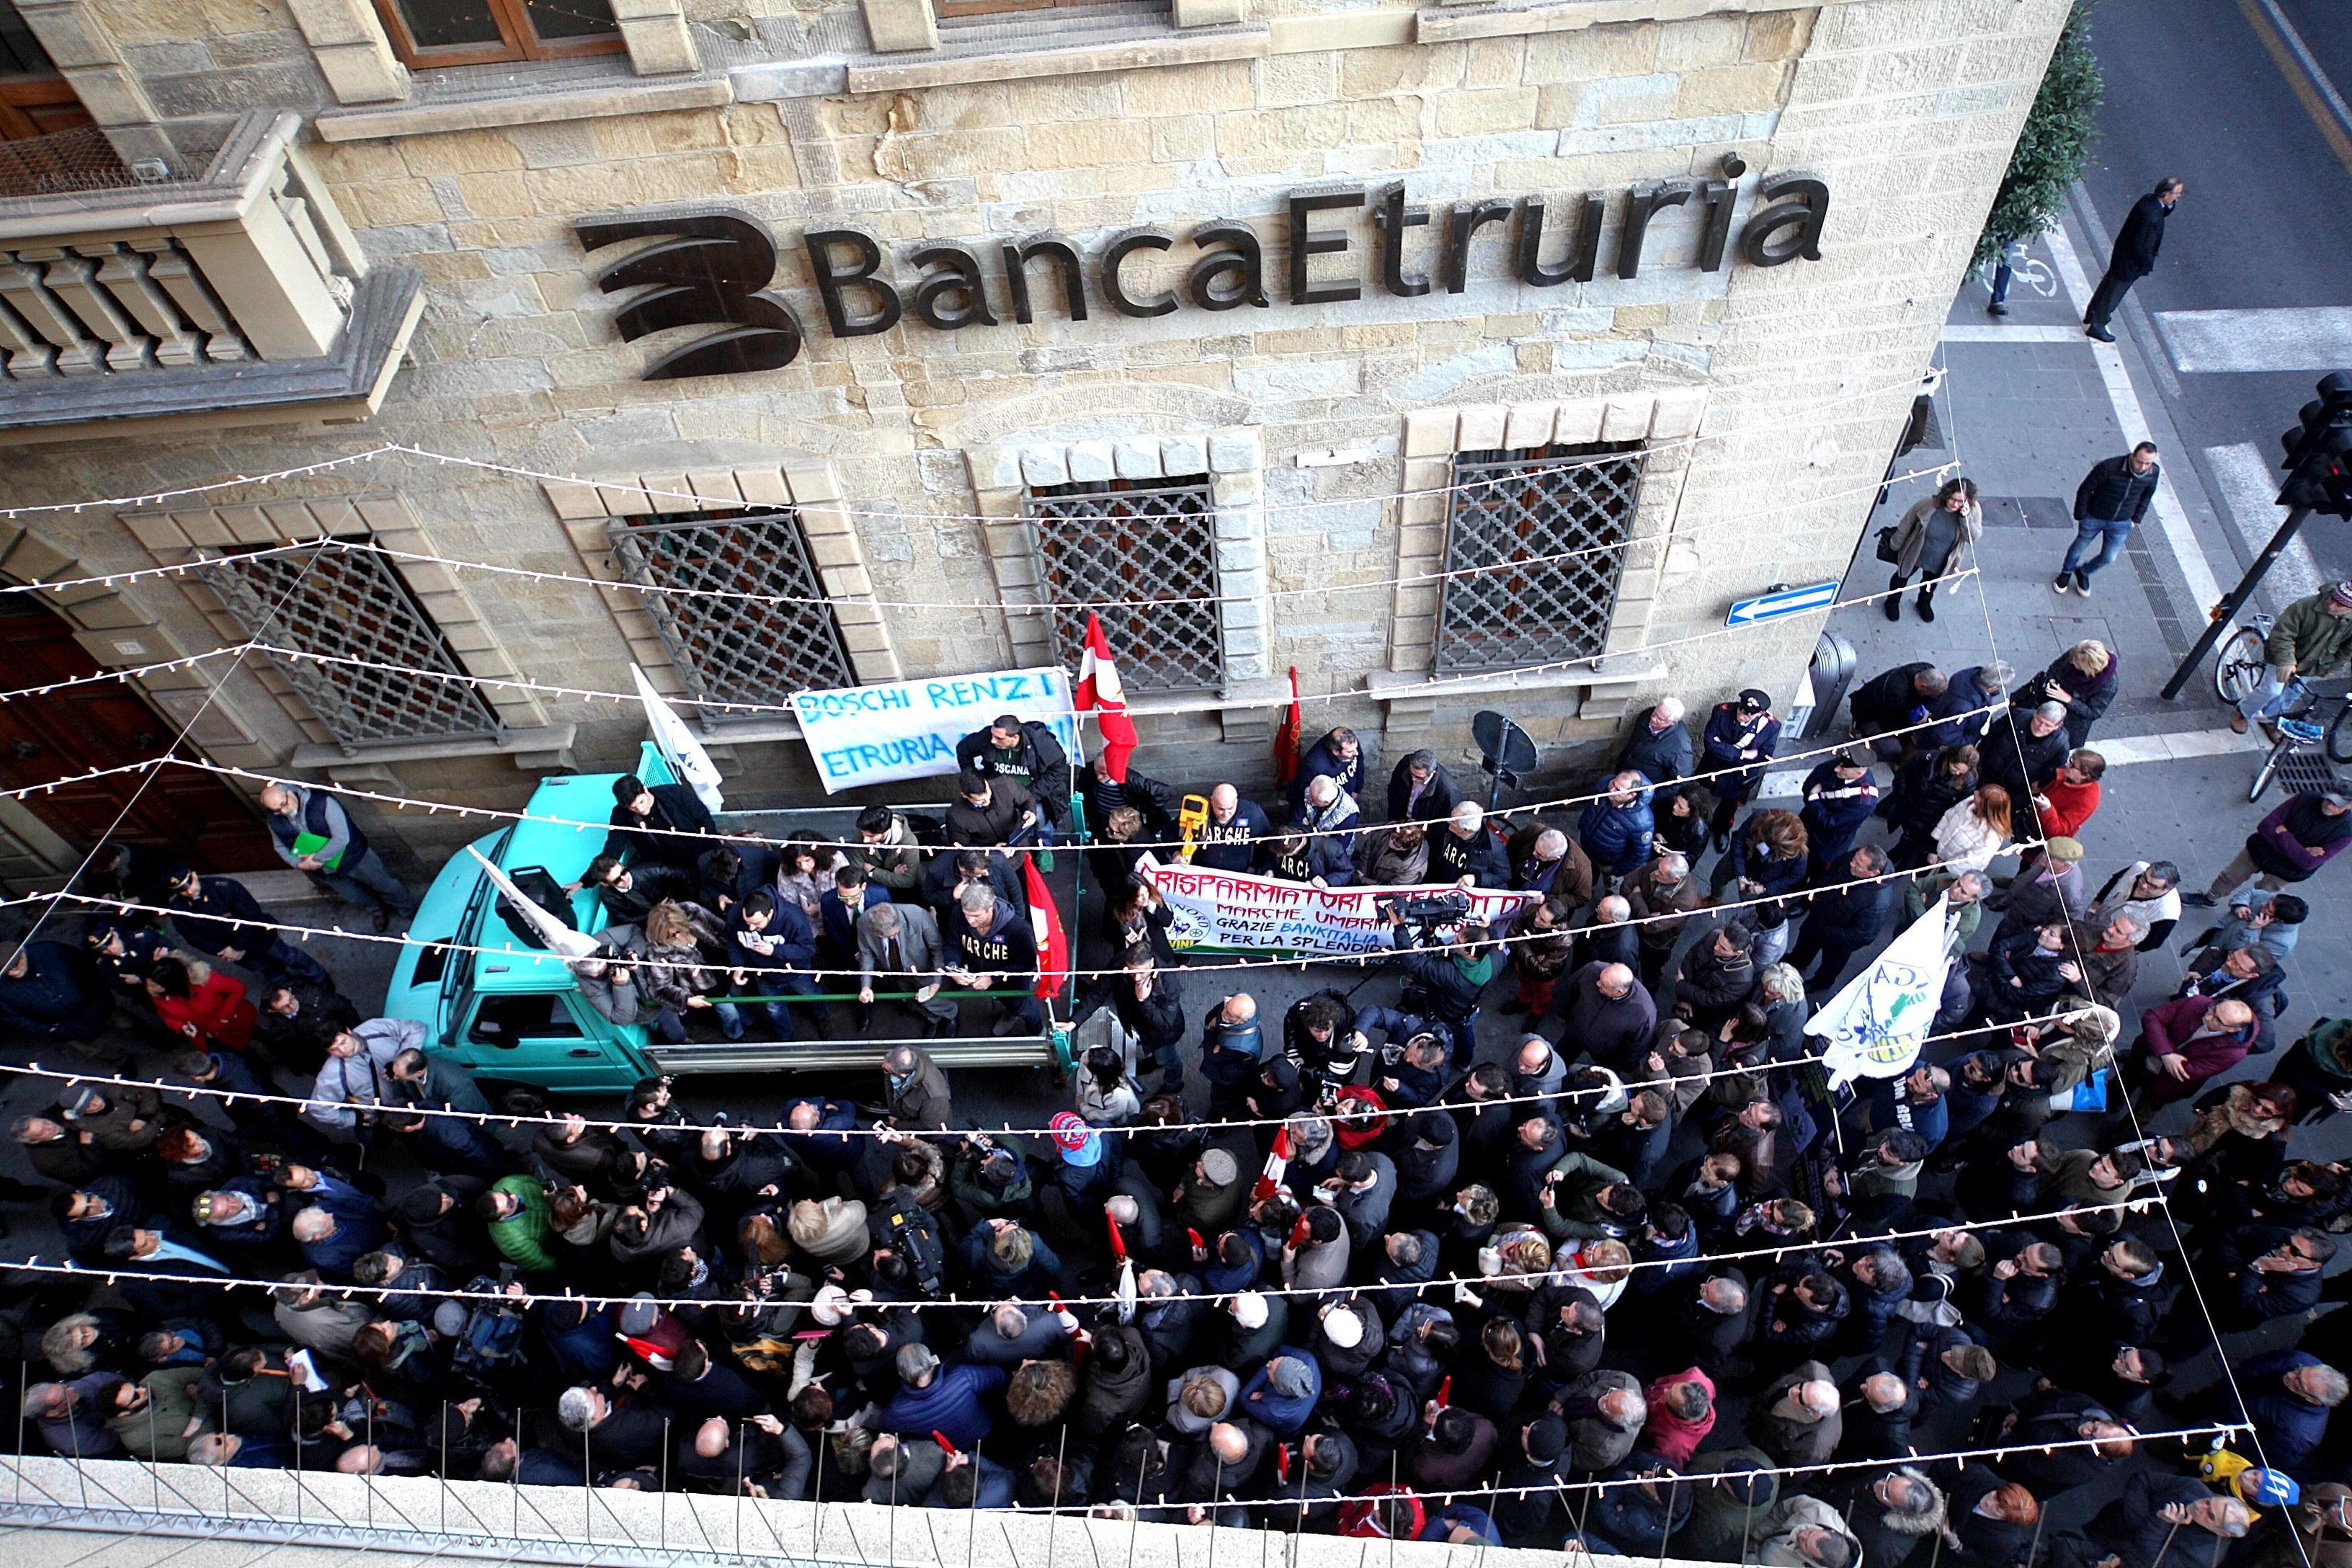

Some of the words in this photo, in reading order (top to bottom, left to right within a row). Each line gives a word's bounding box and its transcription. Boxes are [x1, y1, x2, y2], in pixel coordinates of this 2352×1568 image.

[804, 151, 1830, 338] BancaEtruria
[798, 688, 910, 723] BOSCHI
[927, 673, 1055, 710] RENZI
[821, 734, 955, 778] ETRURIA
[994, 762, 1030, 776] OSCANA
[1206, 826, 1250, 845] ARCHE
[1154, 870, 1363, 915] RISPARMIATORI
[1174, 903, 1209, 928] NORD
[1216, 917, 1275, 932] GRAZIE
[1280, 922, 1378, 945] BANKITALIA
[1220, 932, 1254, 946] PER
[1260, 935, 1283, 946] LA
